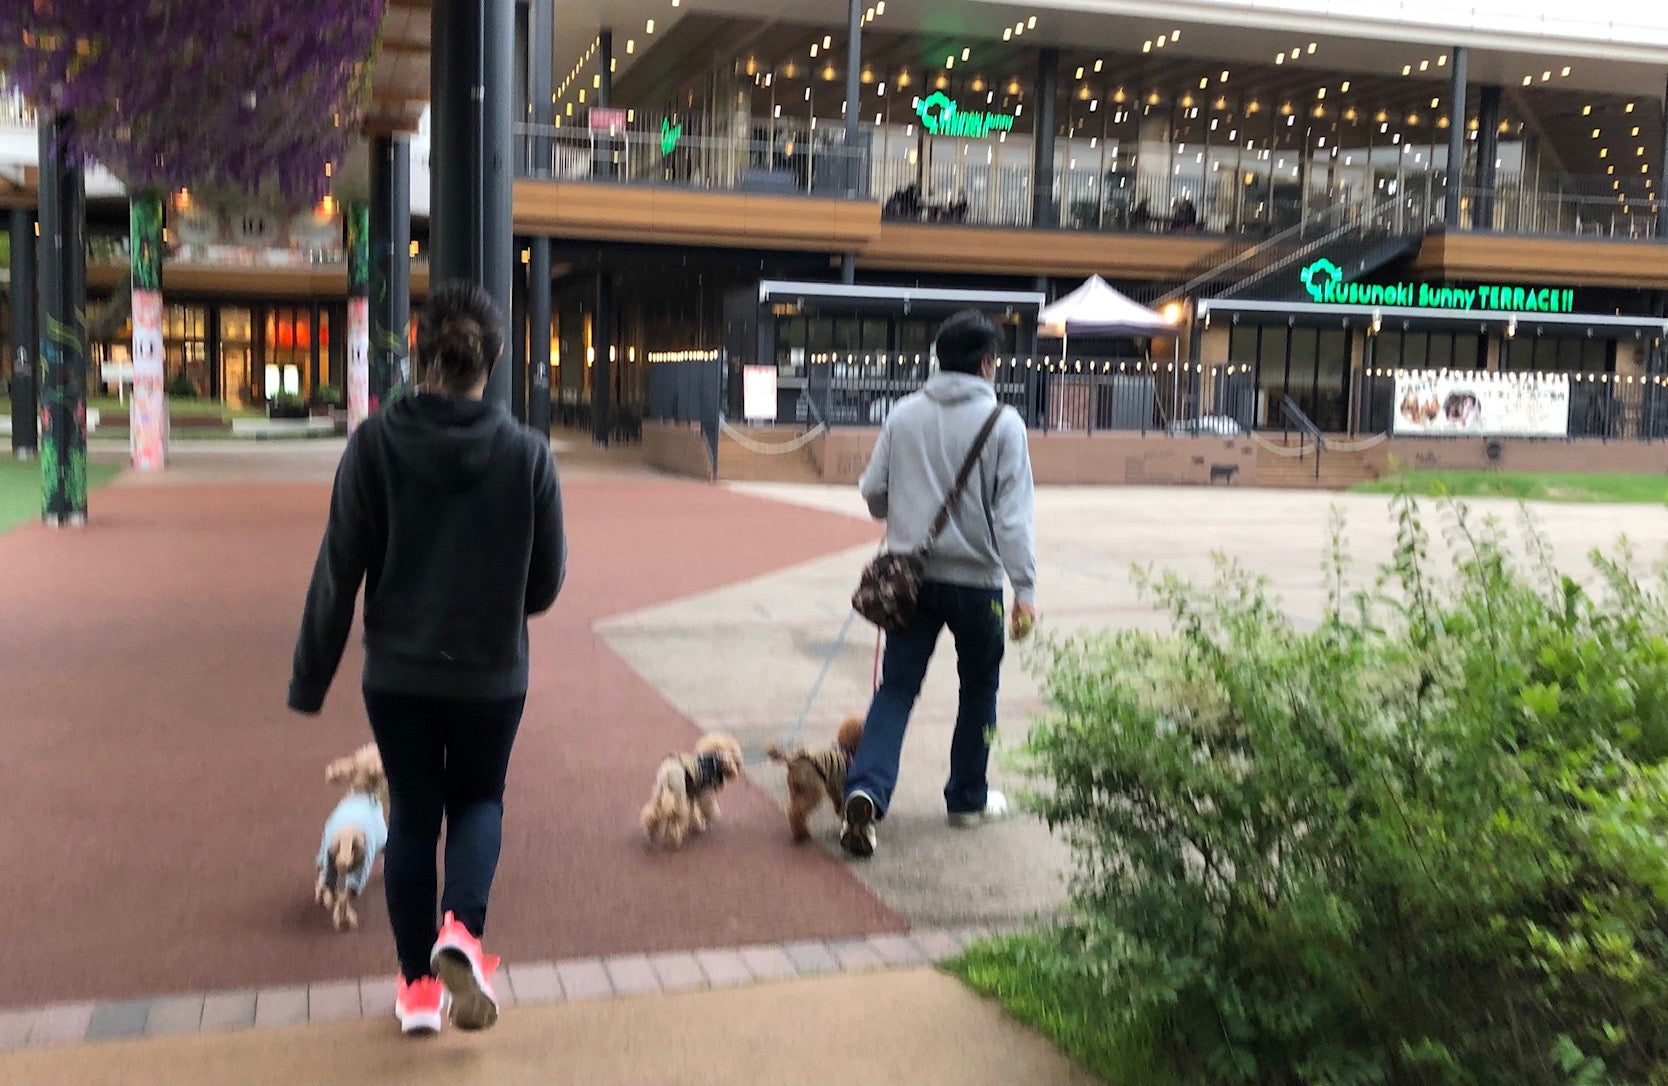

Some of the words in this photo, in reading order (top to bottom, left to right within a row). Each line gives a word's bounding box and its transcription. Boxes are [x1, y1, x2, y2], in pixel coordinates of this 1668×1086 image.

[1325, 279, 1413, 306] Kusunoki
[1419, 283, 1475, 313] Sunny
[1479, 285, 1559, 312] TERRACE
